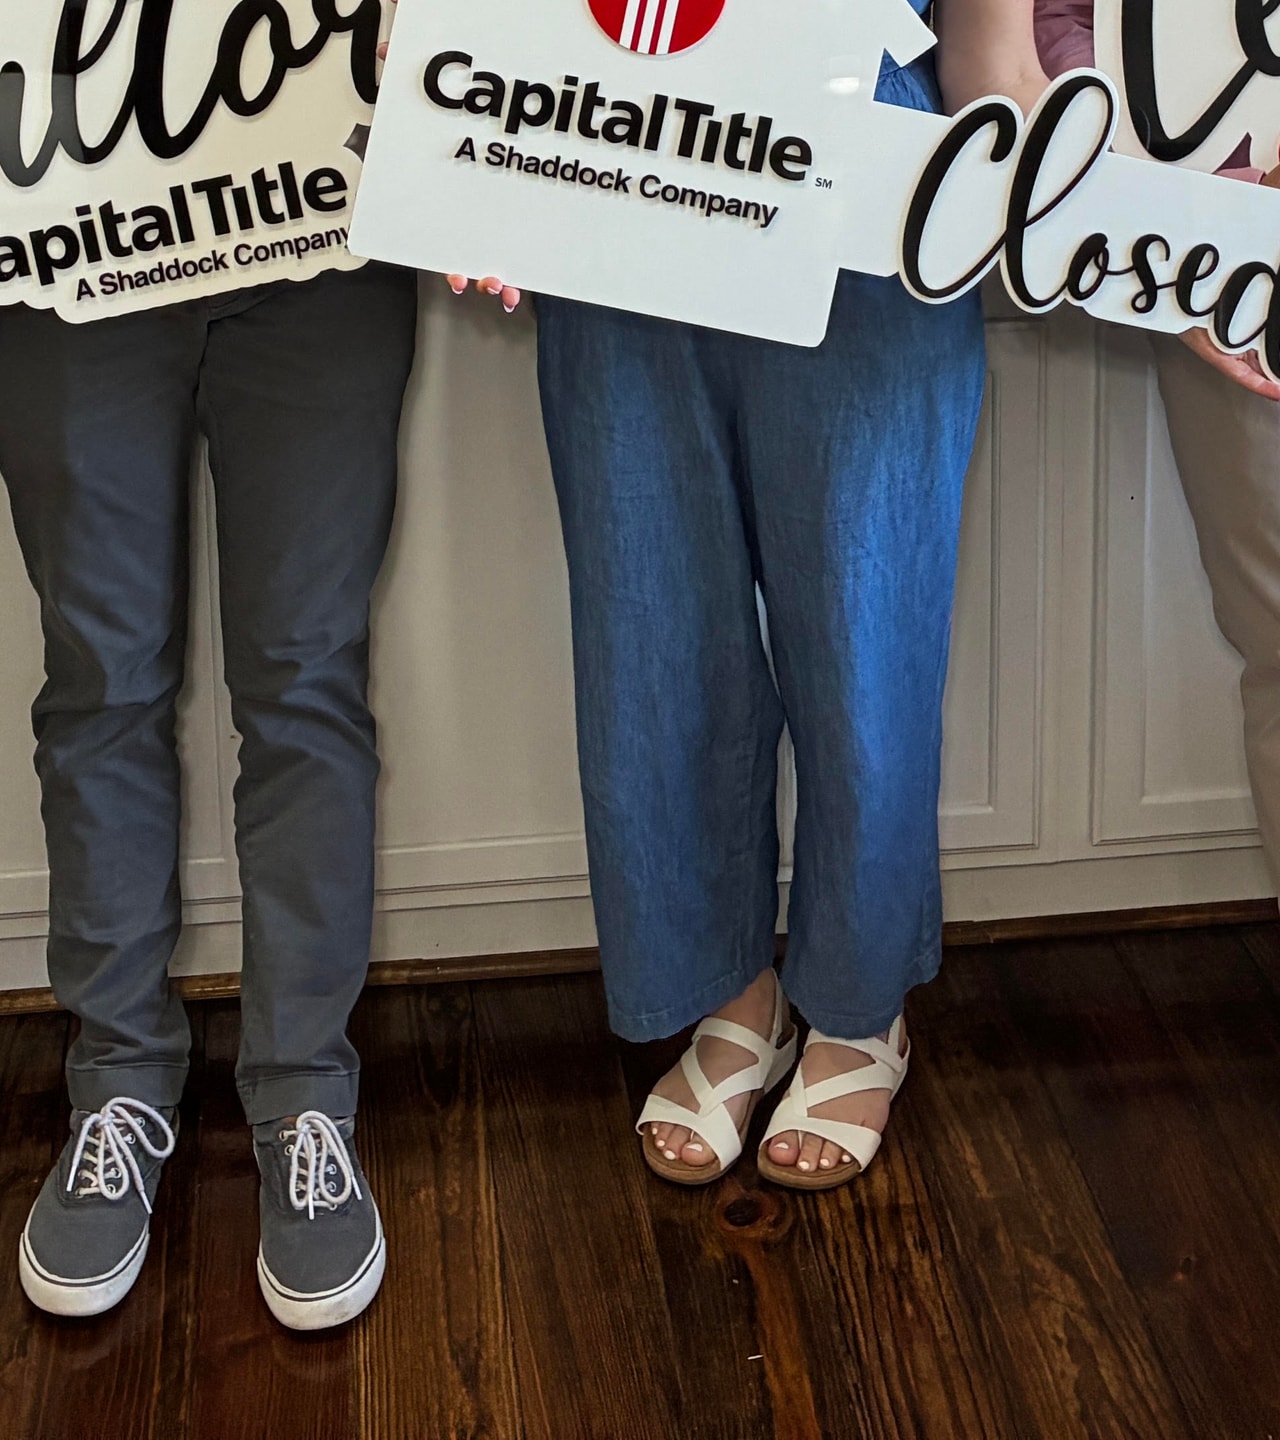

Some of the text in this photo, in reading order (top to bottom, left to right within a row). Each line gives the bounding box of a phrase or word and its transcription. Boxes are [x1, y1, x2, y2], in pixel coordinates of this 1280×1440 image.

[454, 136, 779, 229] A Shaddock Company
[76, 278, 96, 302] A
[98, 249, 230, 296] Shaddock
